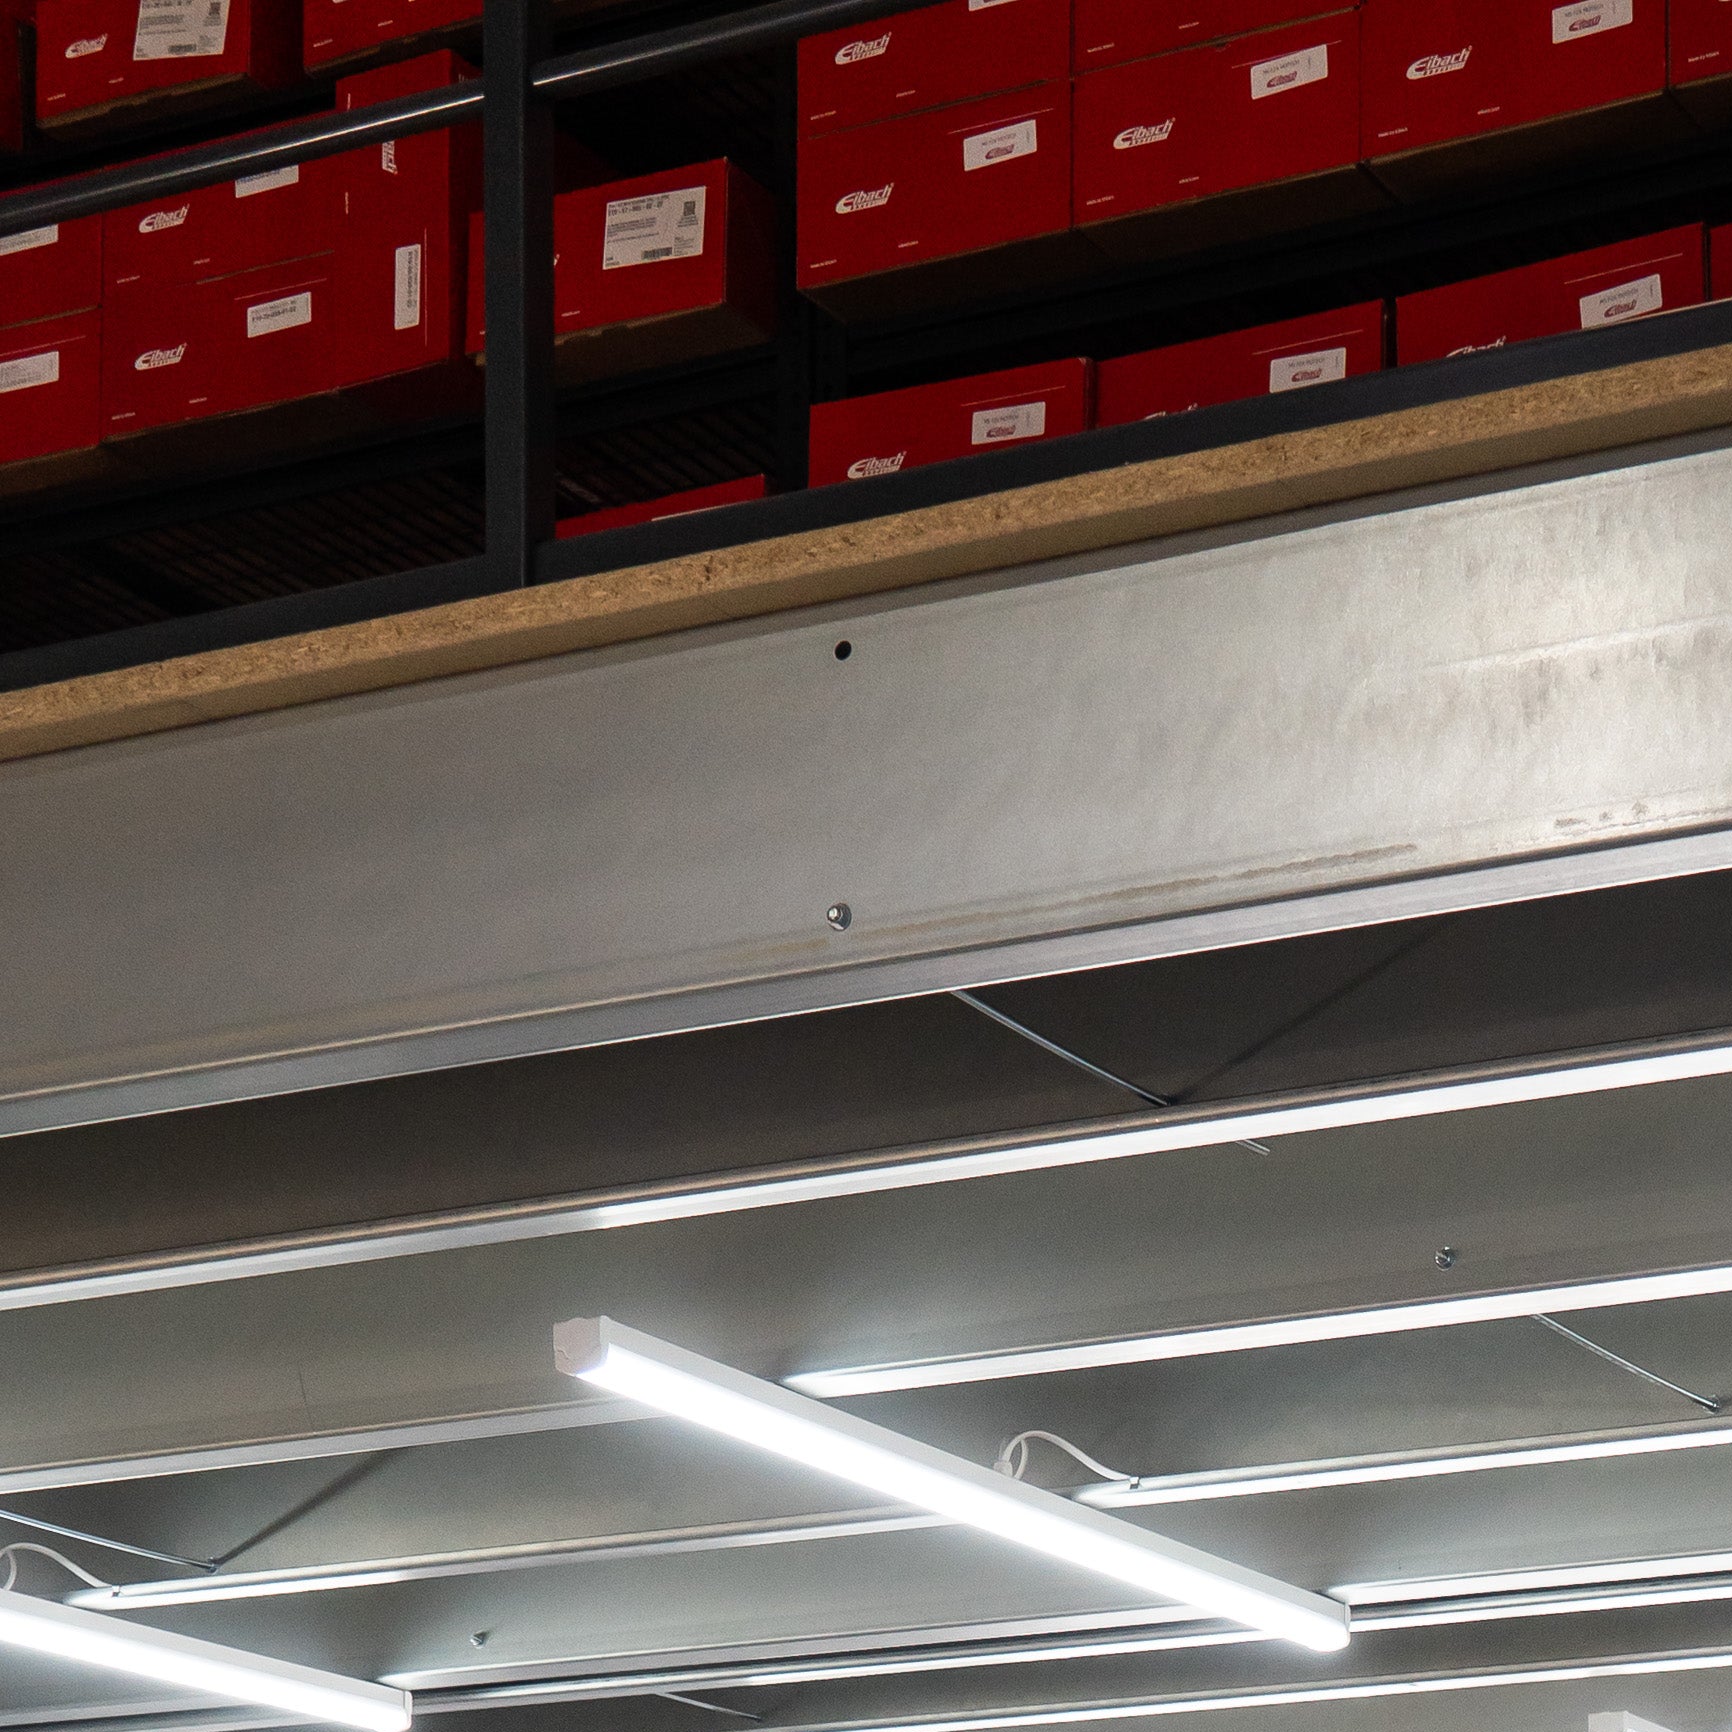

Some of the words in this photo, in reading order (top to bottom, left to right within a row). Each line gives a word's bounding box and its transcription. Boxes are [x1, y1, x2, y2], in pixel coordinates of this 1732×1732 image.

[835, 31, 892, 65] Eibach
[1406, 44, 1472, 81] Eibach
[1113, 117, 1176, 150] Eibach
[835, 182, 894, 214] Eibach
[139, 202, 190, 233] Eibach
[134, 342, 187, 370] Eibach
[847, 450, 907, 480] Eibach
